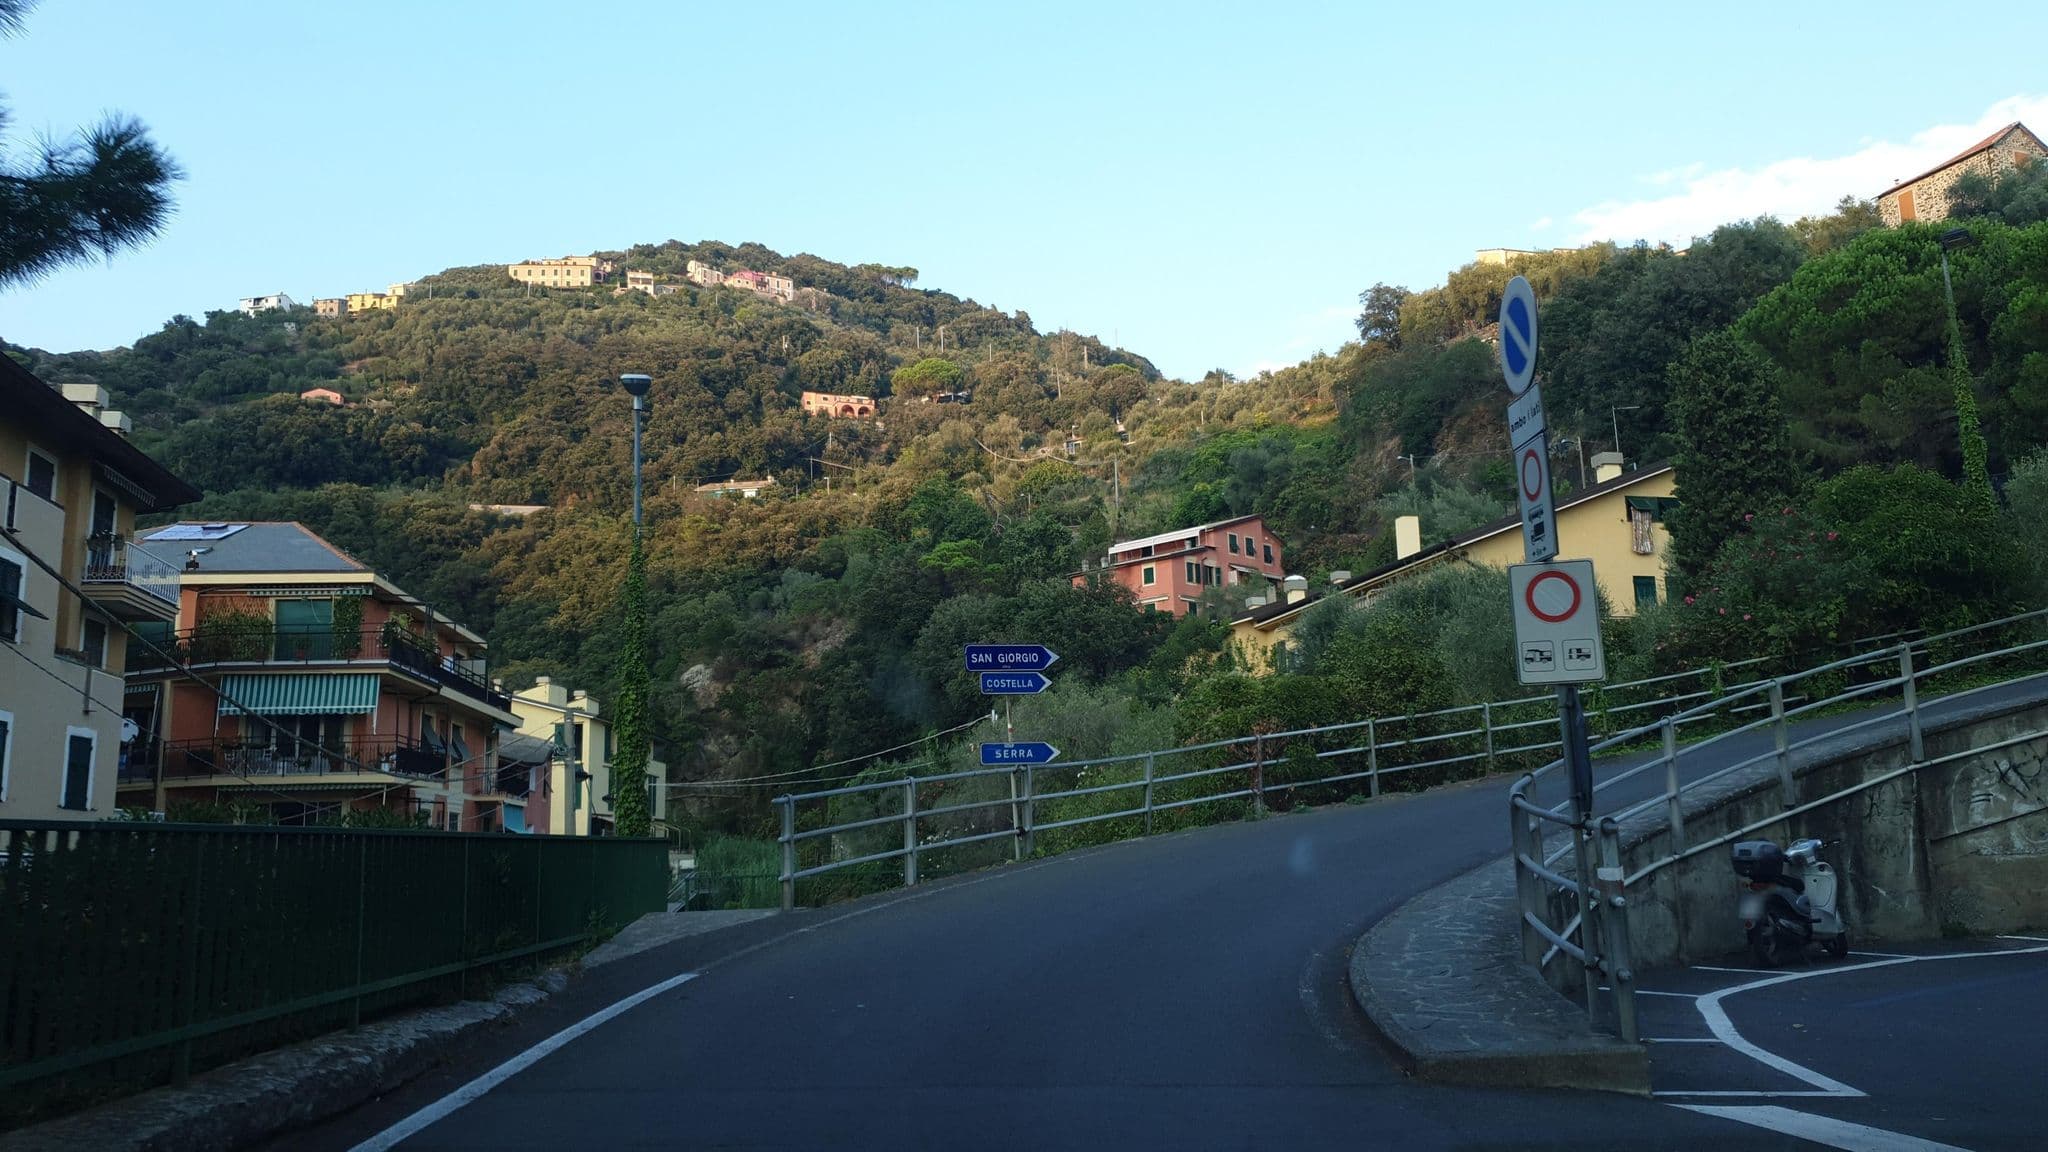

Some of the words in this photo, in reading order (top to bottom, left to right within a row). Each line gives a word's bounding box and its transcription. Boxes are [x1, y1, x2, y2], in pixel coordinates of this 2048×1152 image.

[971, 653, 992, 663] SAN
[997, 653, 1039, 663] GIORGIO
[986, 679, 1034, 688] COSTELLA
[995, 749, 1034, 759] SERRA
